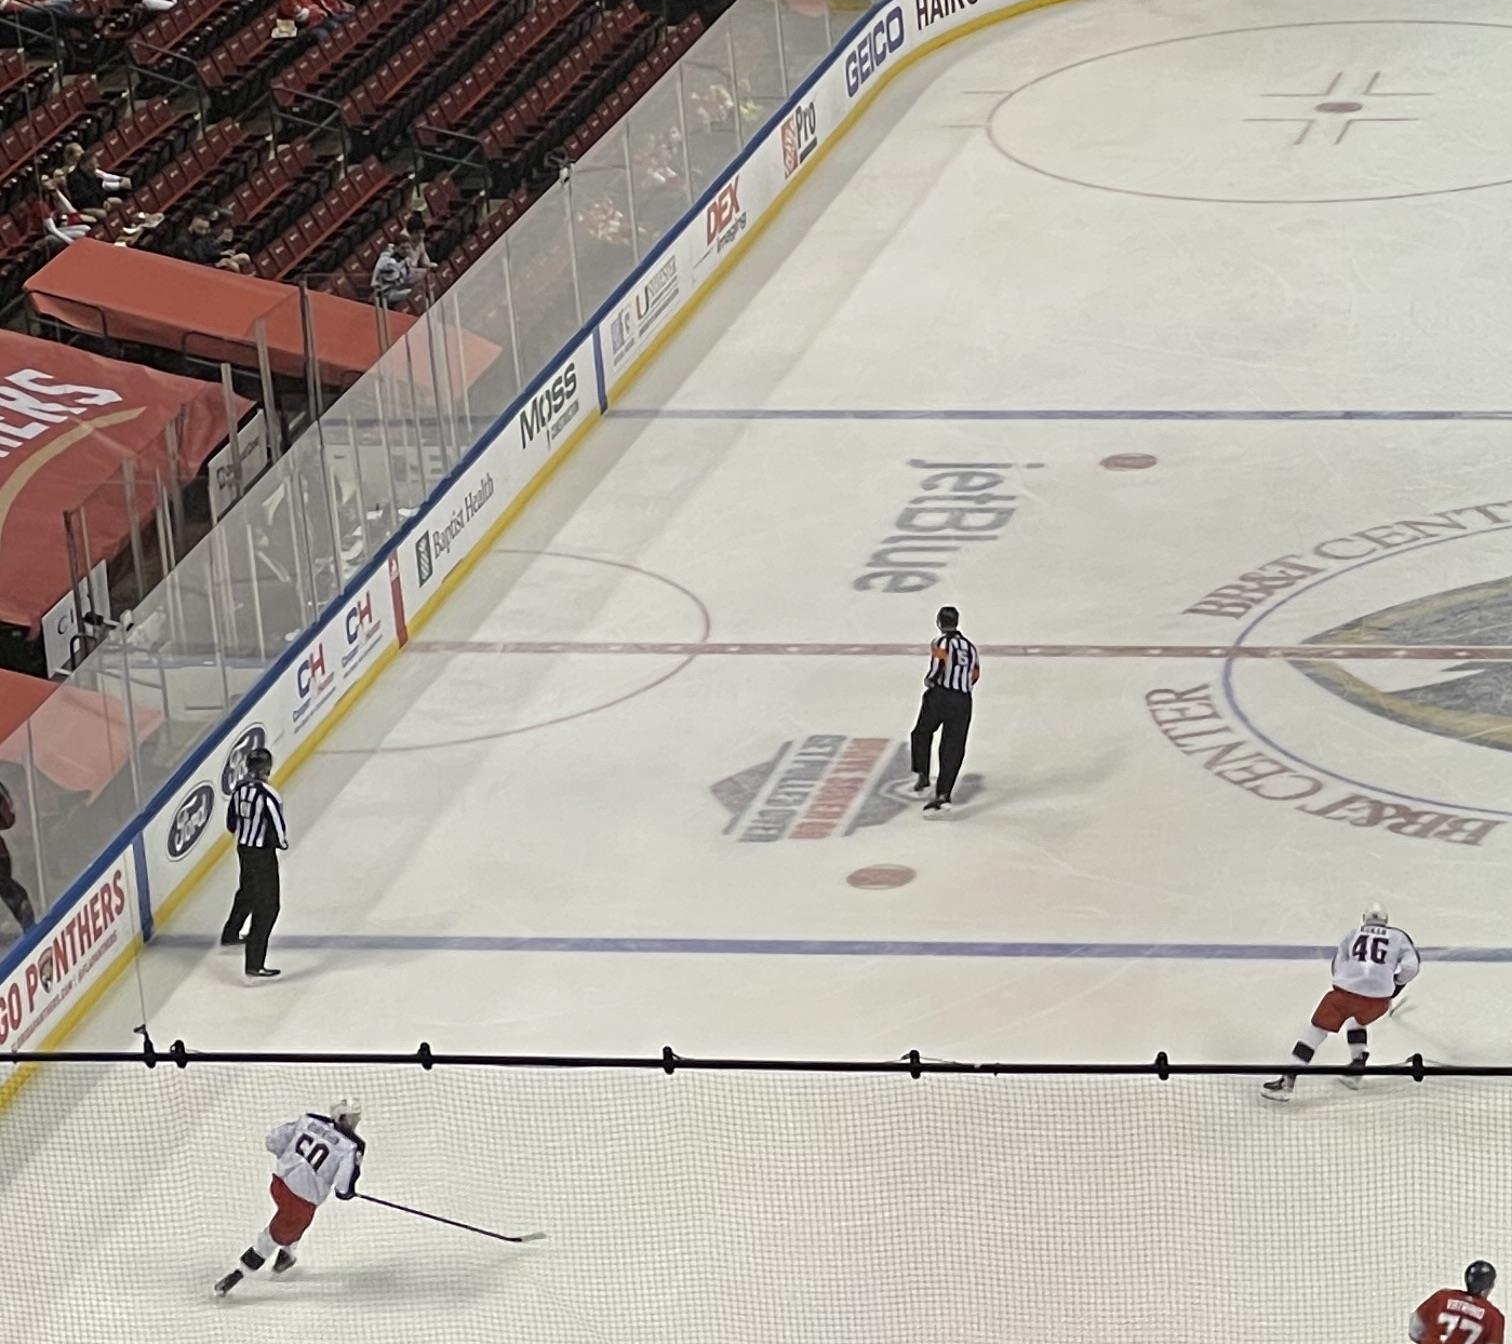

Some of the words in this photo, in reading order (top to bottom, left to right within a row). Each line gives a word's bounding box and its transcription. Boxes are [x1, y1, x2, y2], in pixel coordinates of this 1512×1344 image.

[844, 6, 905, 98] GEICO
[796, 100, 817, 147] Pro
[706, 174, 742, 247] DEX
[520, 362, 577, 450] MOSS
[433, 501, 464, 561] Baptist
[464, 471, 496, 523] Health
[850, 458, 1046, 595] jetBlue
[346, 591, 373, 645] CH
[1182, 553, 1326, 621] BB&T
[297, 642, 325, 698] CH
[1144, 683, 1323, 802] CENTER
[174, 793, 208, 852] Ford
[1293, 791, 1509, 846] BB&T
[1352, 937, 1389, 964] 46
